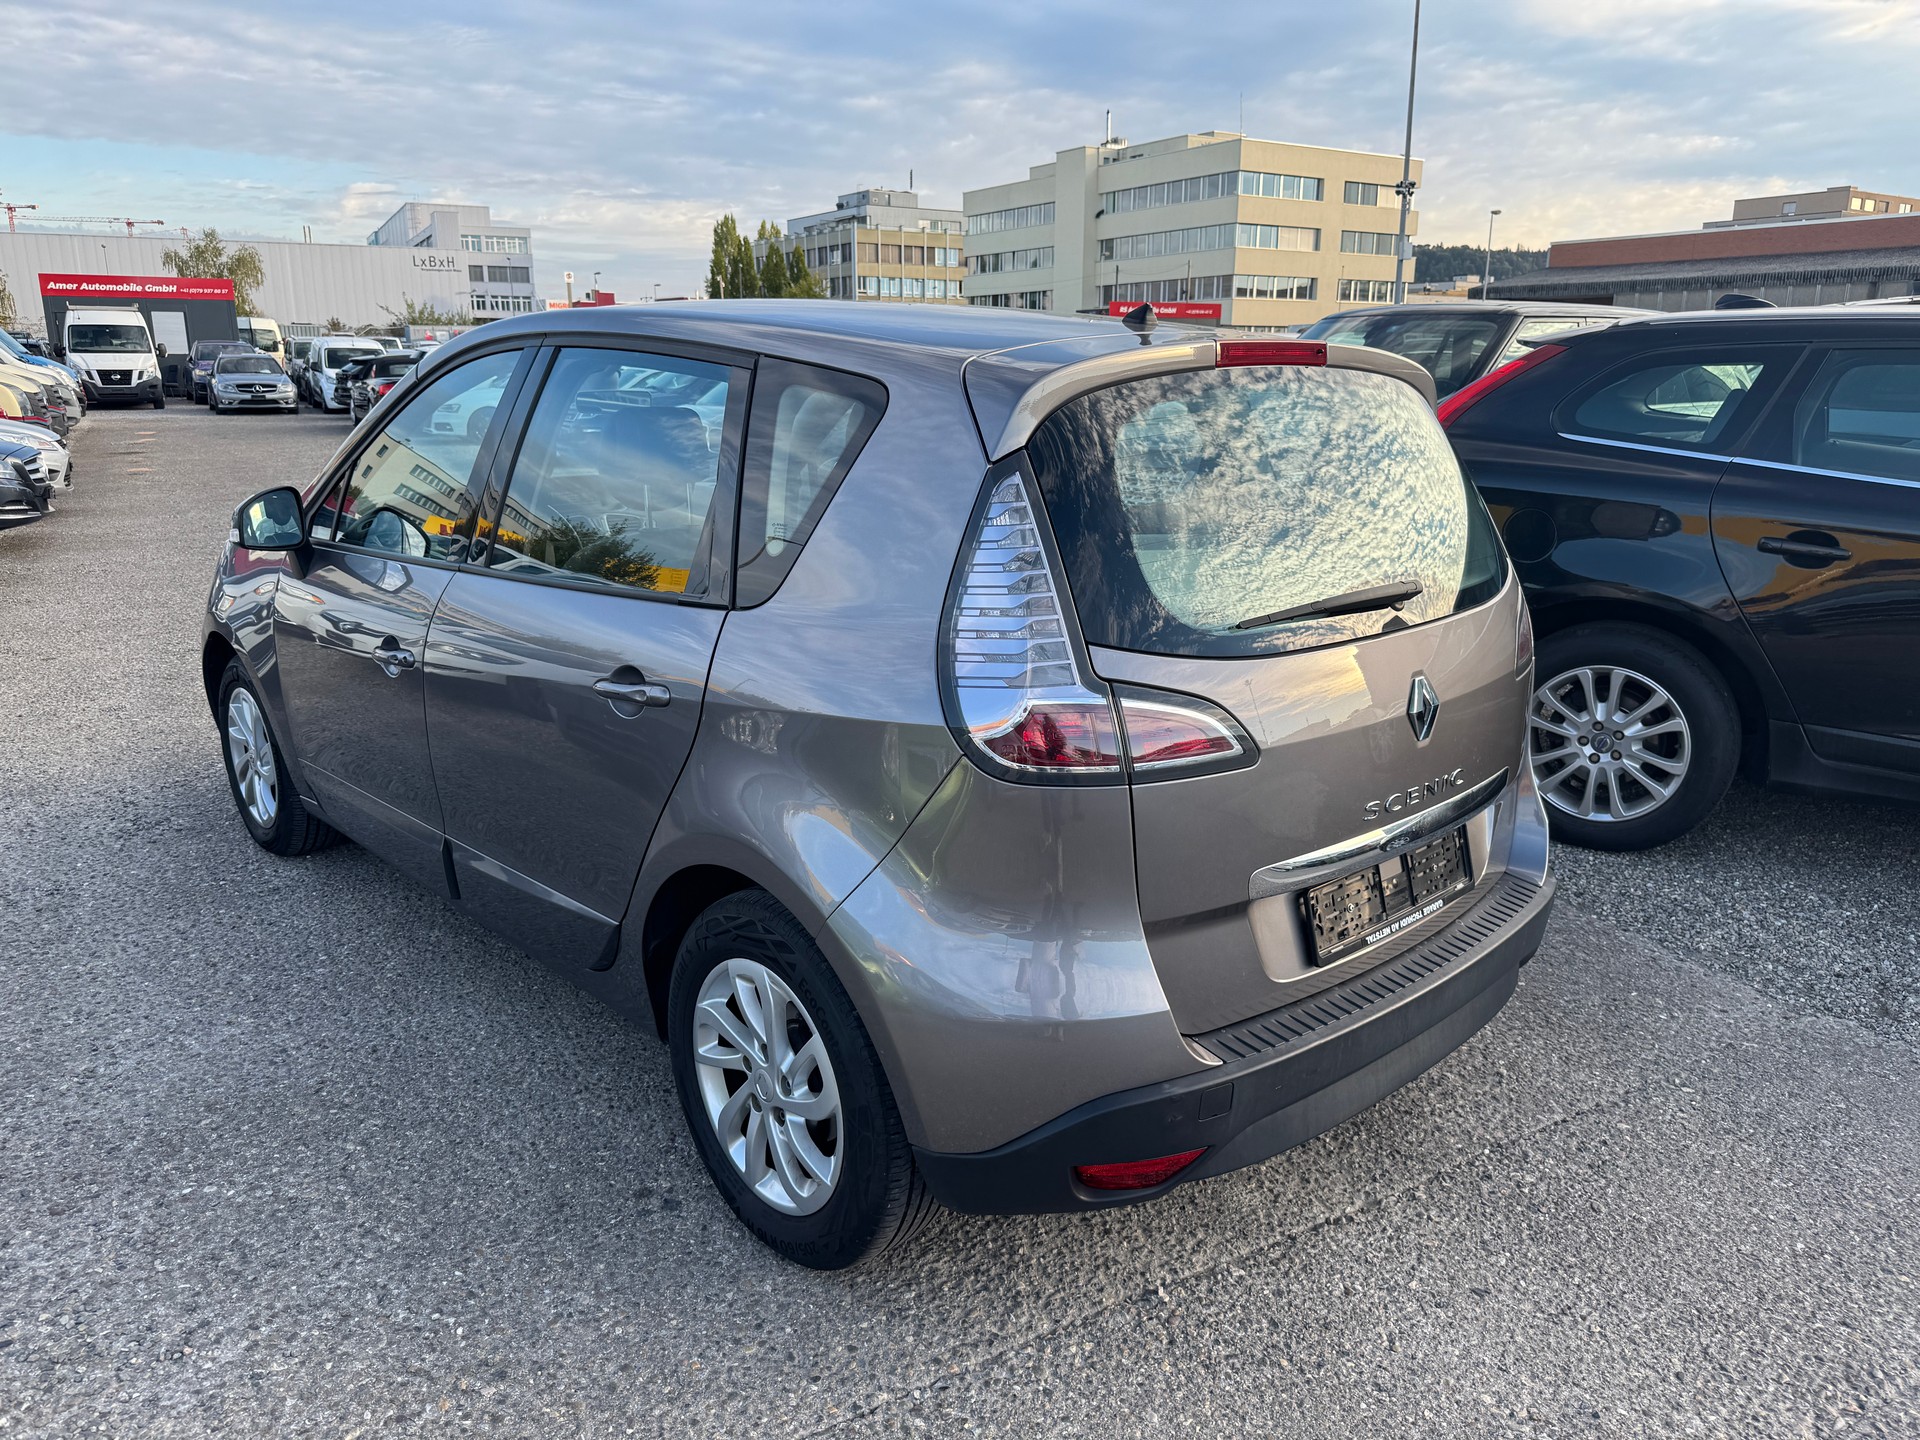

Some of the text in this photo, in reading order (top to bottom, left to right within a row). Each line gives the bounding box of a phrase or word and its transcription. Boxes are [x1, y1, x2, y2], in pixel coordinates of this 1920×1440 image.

[47, 281, 78, 291] Amer
[80, 283, 142, 292] Automobile
[145, 284, 176, 293] GmbH
[1362, 768, 1465, 821] SCENIC
[1422, 899, 1444, 916] GARAGE
[1399, 910, 1423, 928] TSCHUDI
[1365, 925, 1391, 944] NETSTAL
